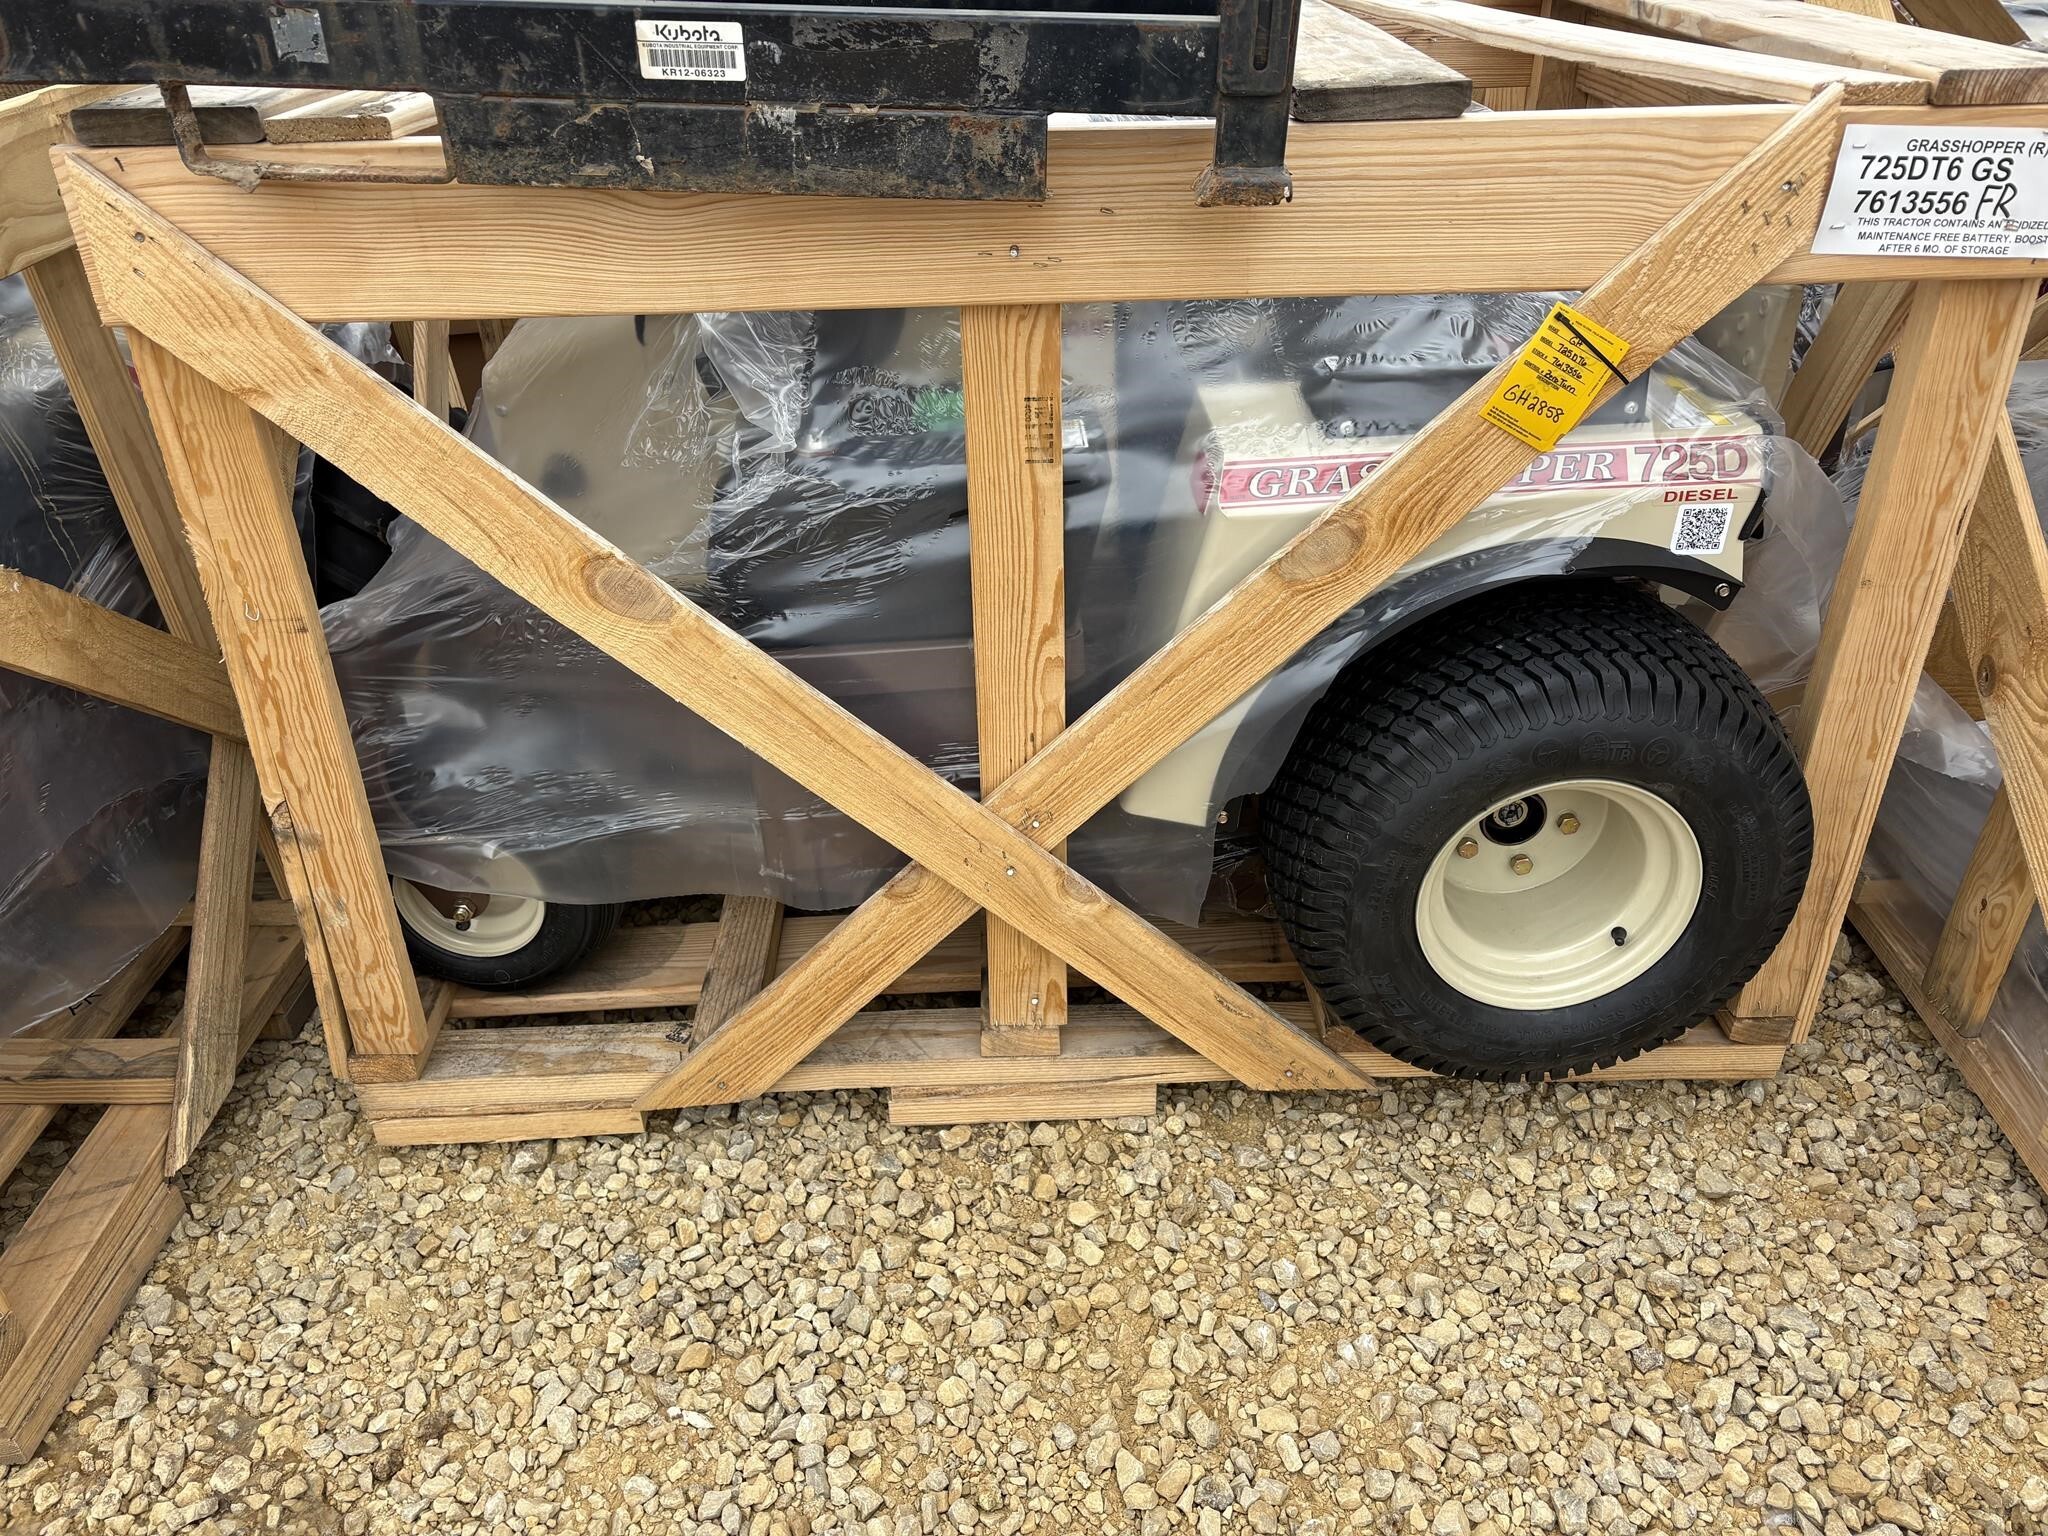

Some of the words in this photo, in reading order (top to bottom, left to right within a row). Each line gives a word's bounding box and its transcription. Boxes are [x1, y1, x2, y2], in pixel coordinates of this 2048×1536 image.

[655, 24, 721, 41] Kubota
[662, 68, 726, 77] KR12-06323
[1907, 139, 2026, 154] GRASSHOPPER
[1860, 155, 1965, 181] 725DT6
[1971, 156, 2015, 182] GS
[1854, 190, 1970, 214] 7613556
[1974, 182, 2018, 220] FR
[1857, 217, 1880, 226] THIS
[1883, 217, 1931, 227] TRACTOR
[1934, 218, 1985, 228] CONTAINS
[1987, 219, 2002, 228] AN
[1857, 231, 1931, 241] MAINTENANCE
[1933, 232, 1960, 242] FREE
[1963, 233, 2012, 243] BATTERY.
[1878, 244, 1912, 253] AFTER
[1914, 244, 1920, 253] 6
[1922, 244, 1941, 254] MO.
[1944, 245, 1960, 254] OF
[1961, 245, 2010, 255] STORAGE
[1503, 384, 1565, 423] GH2858
[1634, 442, 1748, 483] 725D
[1664, 488, 1738, 503] DIESEL
